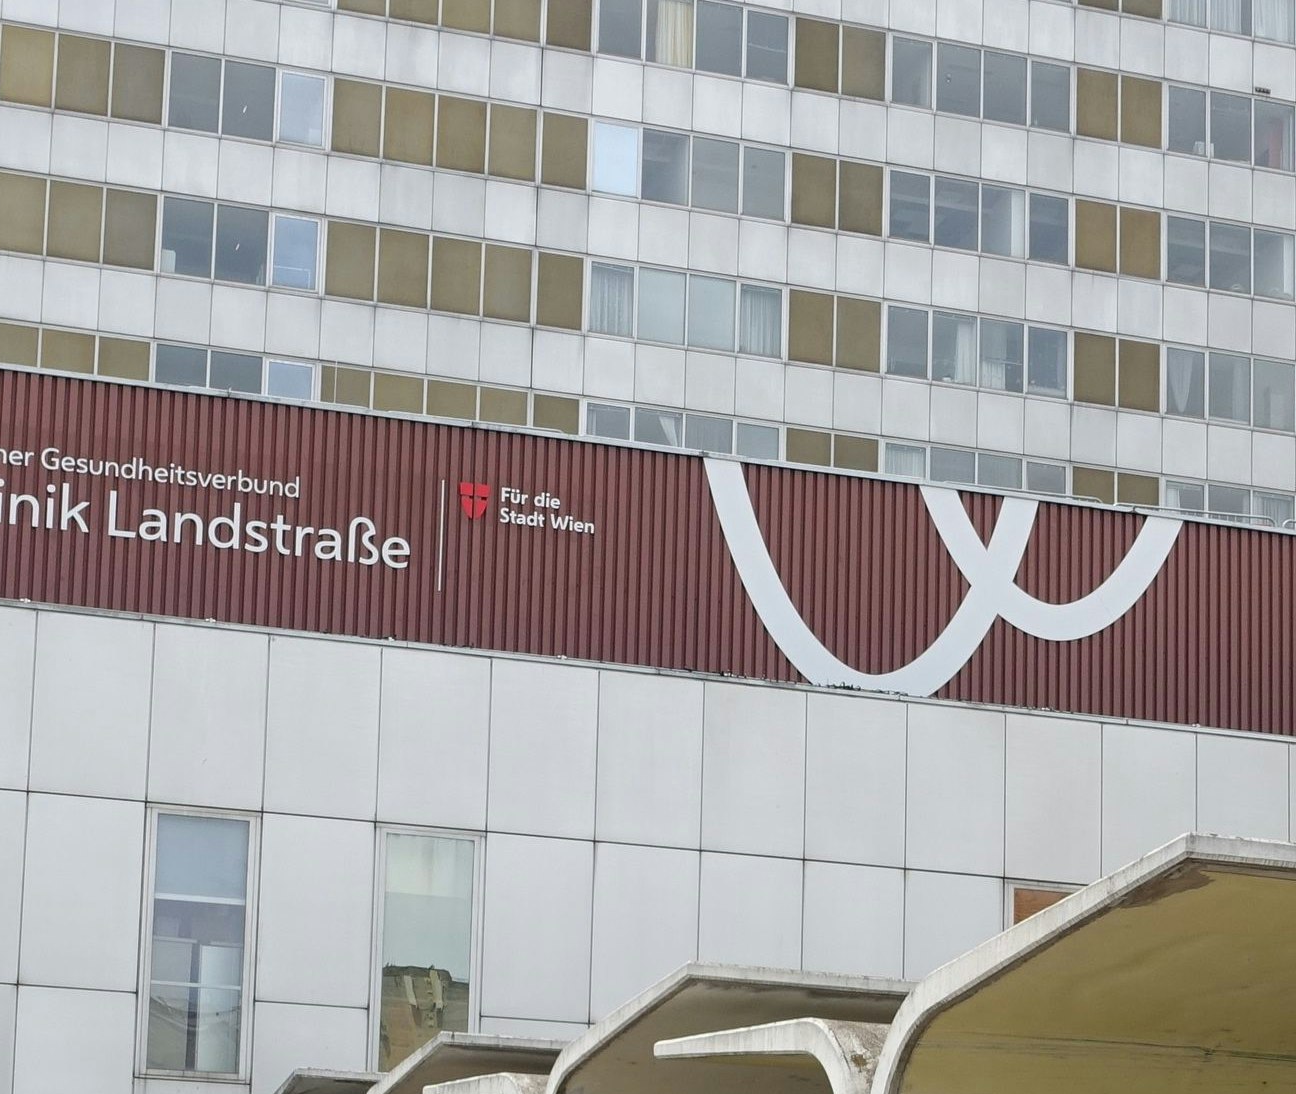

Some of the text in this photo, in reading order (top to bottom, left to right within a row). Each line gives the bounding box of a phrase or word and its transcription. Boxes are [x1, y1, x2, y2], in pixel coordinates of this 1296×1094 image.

[40, 447, 300, 498] Gesundheitsverbund
[501, 487, 561, 510] Für die
[107, 490, 412, 570] Landstraße
[500, 507, 595, 534] Stadt Wien
